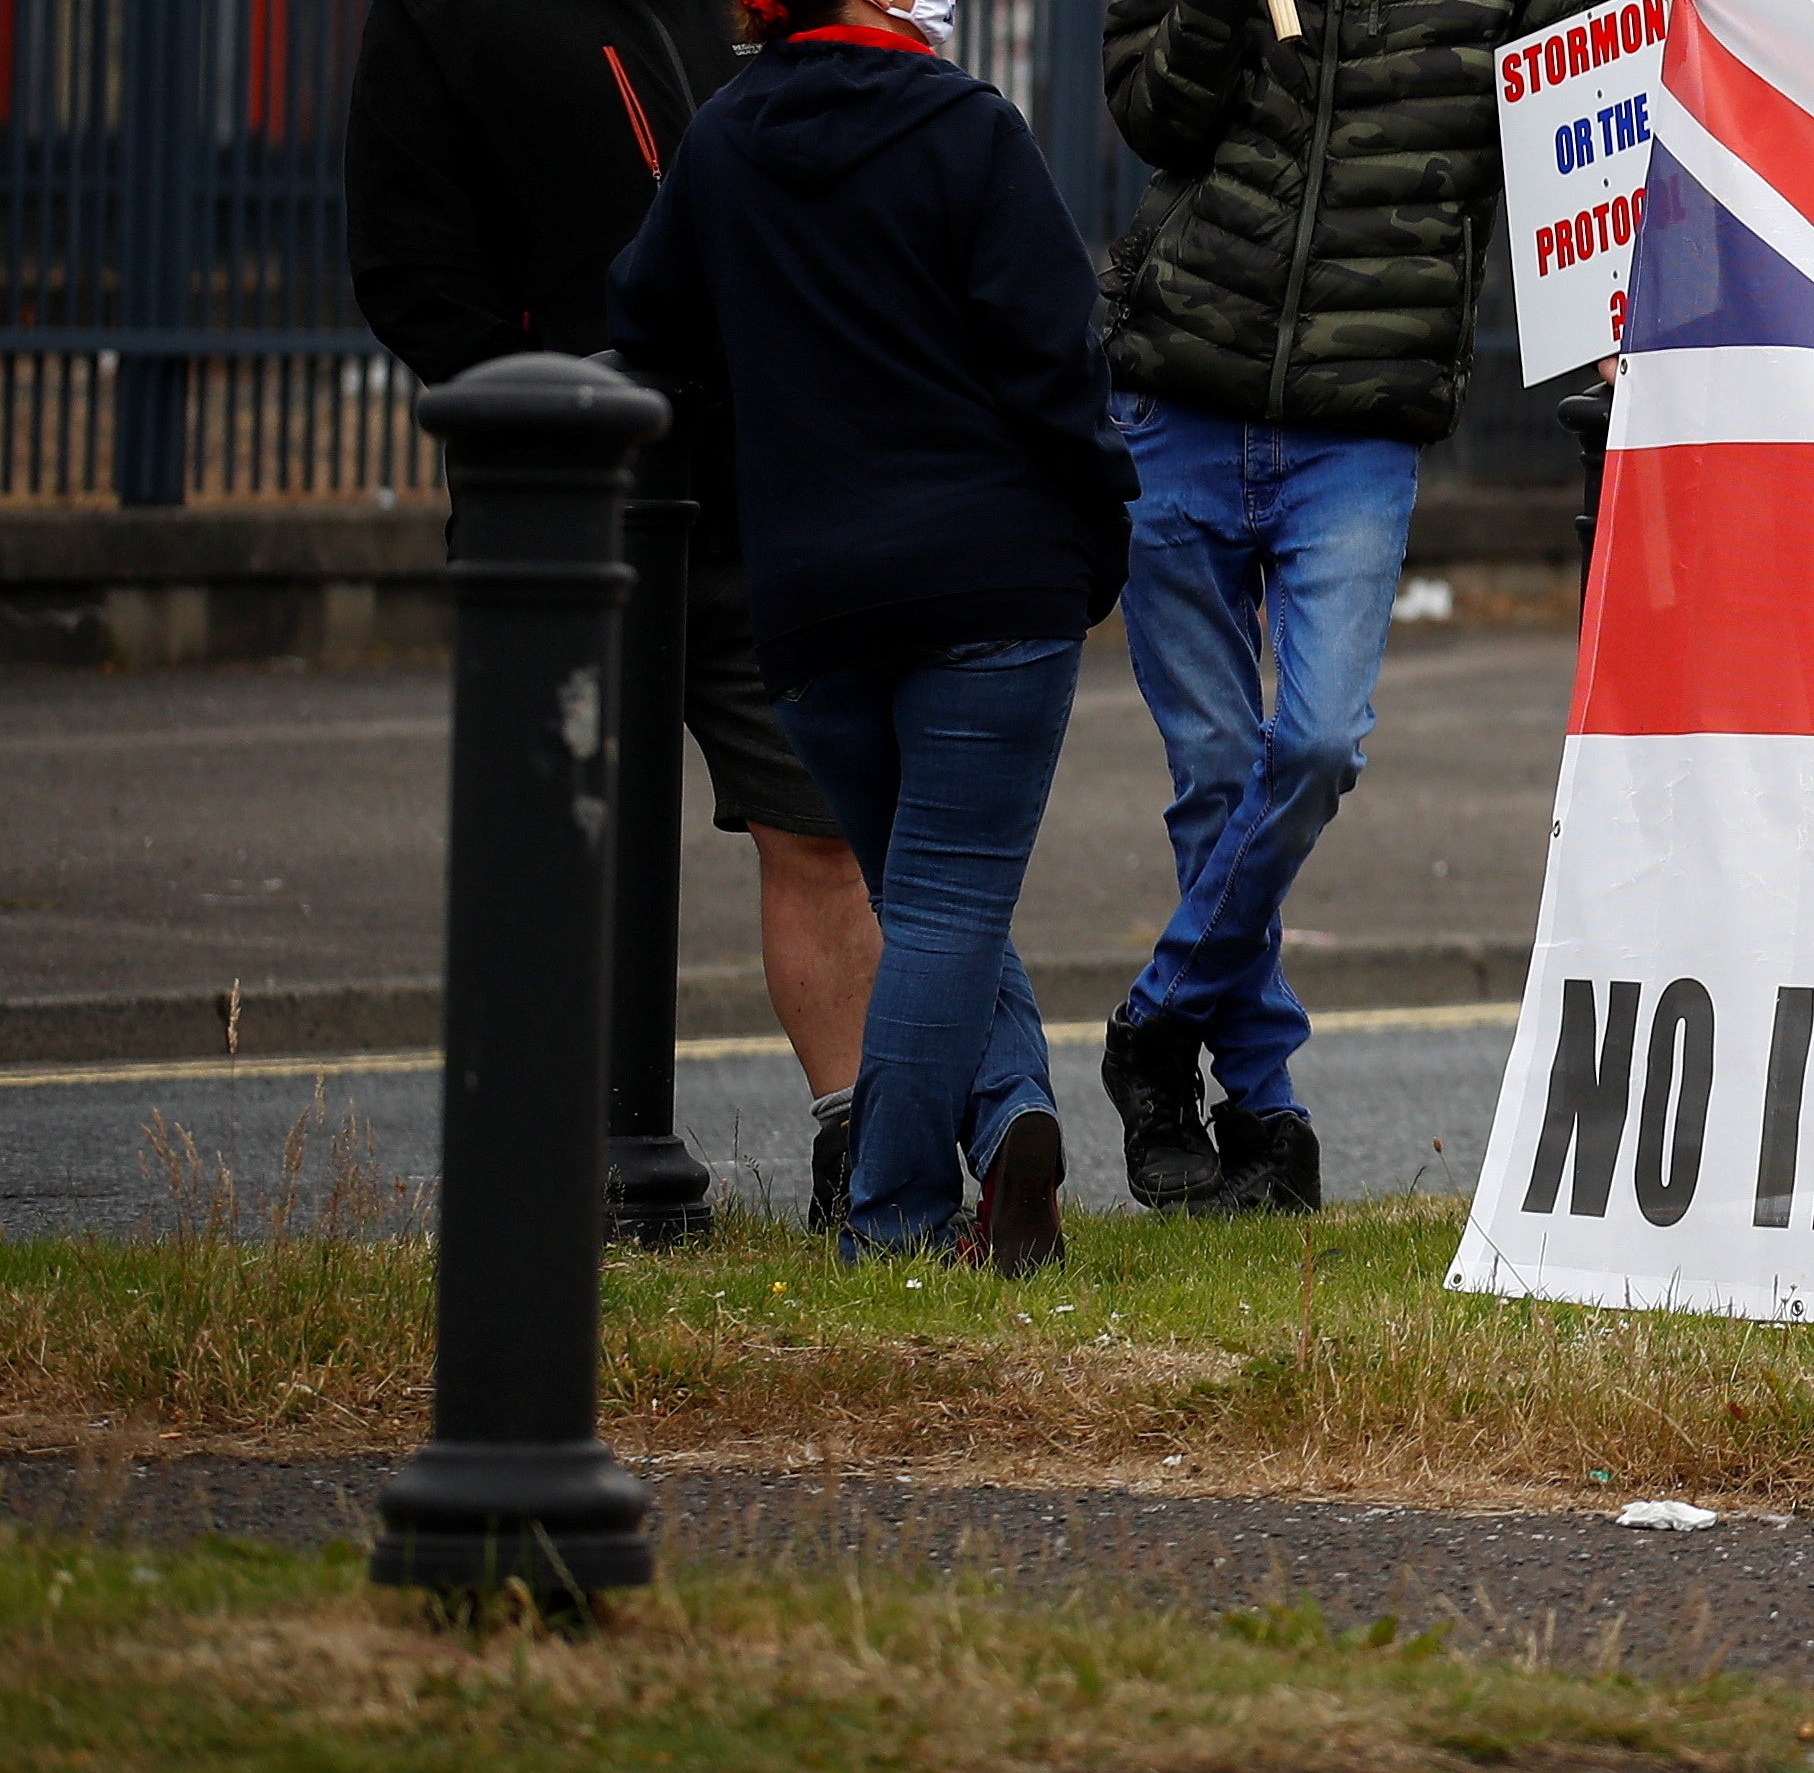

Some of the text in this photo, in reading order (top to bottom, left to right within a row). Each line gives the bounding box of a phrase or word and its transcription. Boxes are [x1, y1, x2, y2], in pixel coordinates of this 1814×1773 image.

[1555, 92, 1651, 175] OR THE
[1521, 978, 1714, 1228] NO
